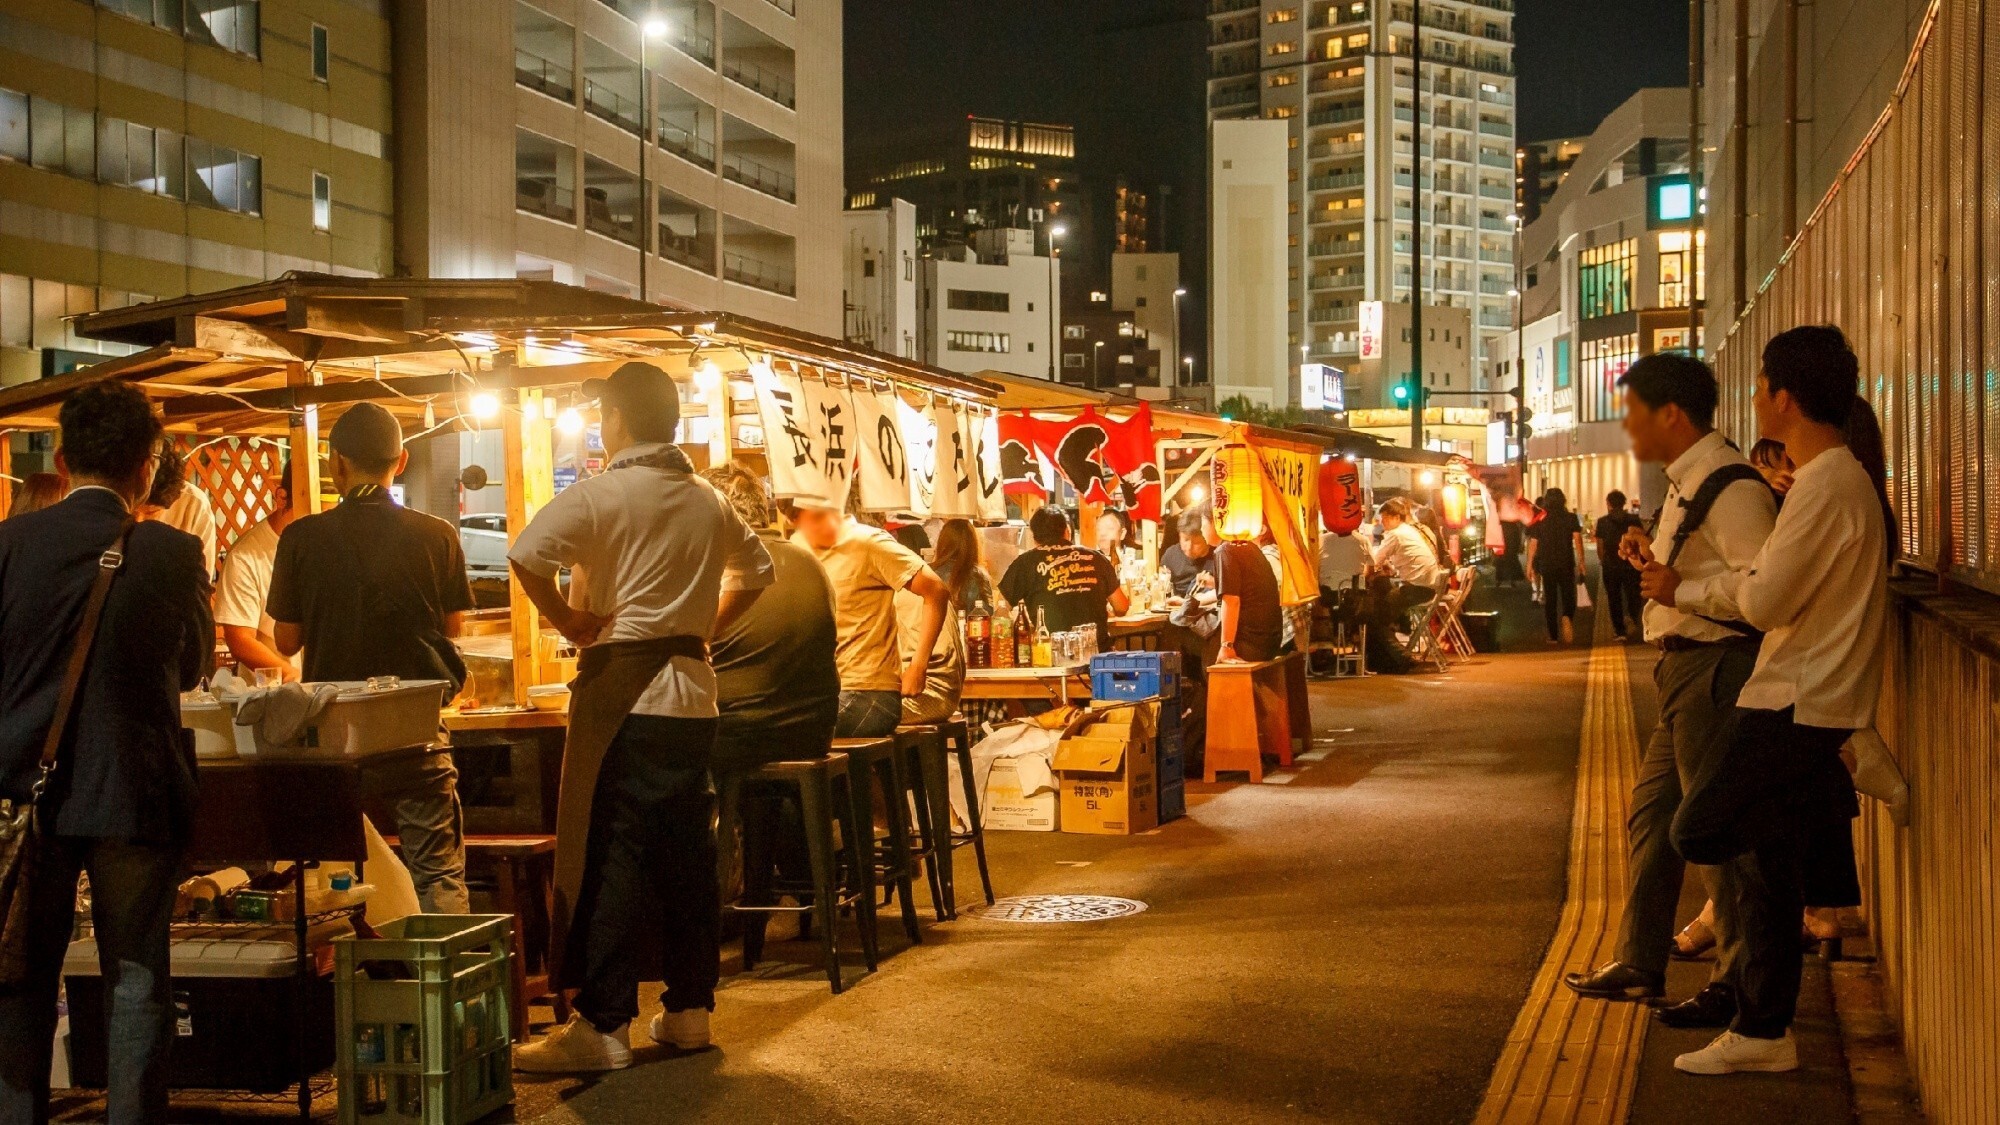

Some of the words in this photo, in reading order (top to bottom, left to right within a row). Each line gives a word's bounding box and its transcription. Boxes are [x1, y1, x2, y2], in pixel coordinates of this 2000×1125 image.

[1661, 335, 1680, 347] 2F
[1336, 473, 1360, 520] ラーメン
[1086, 800, 1102, 810] 5L
